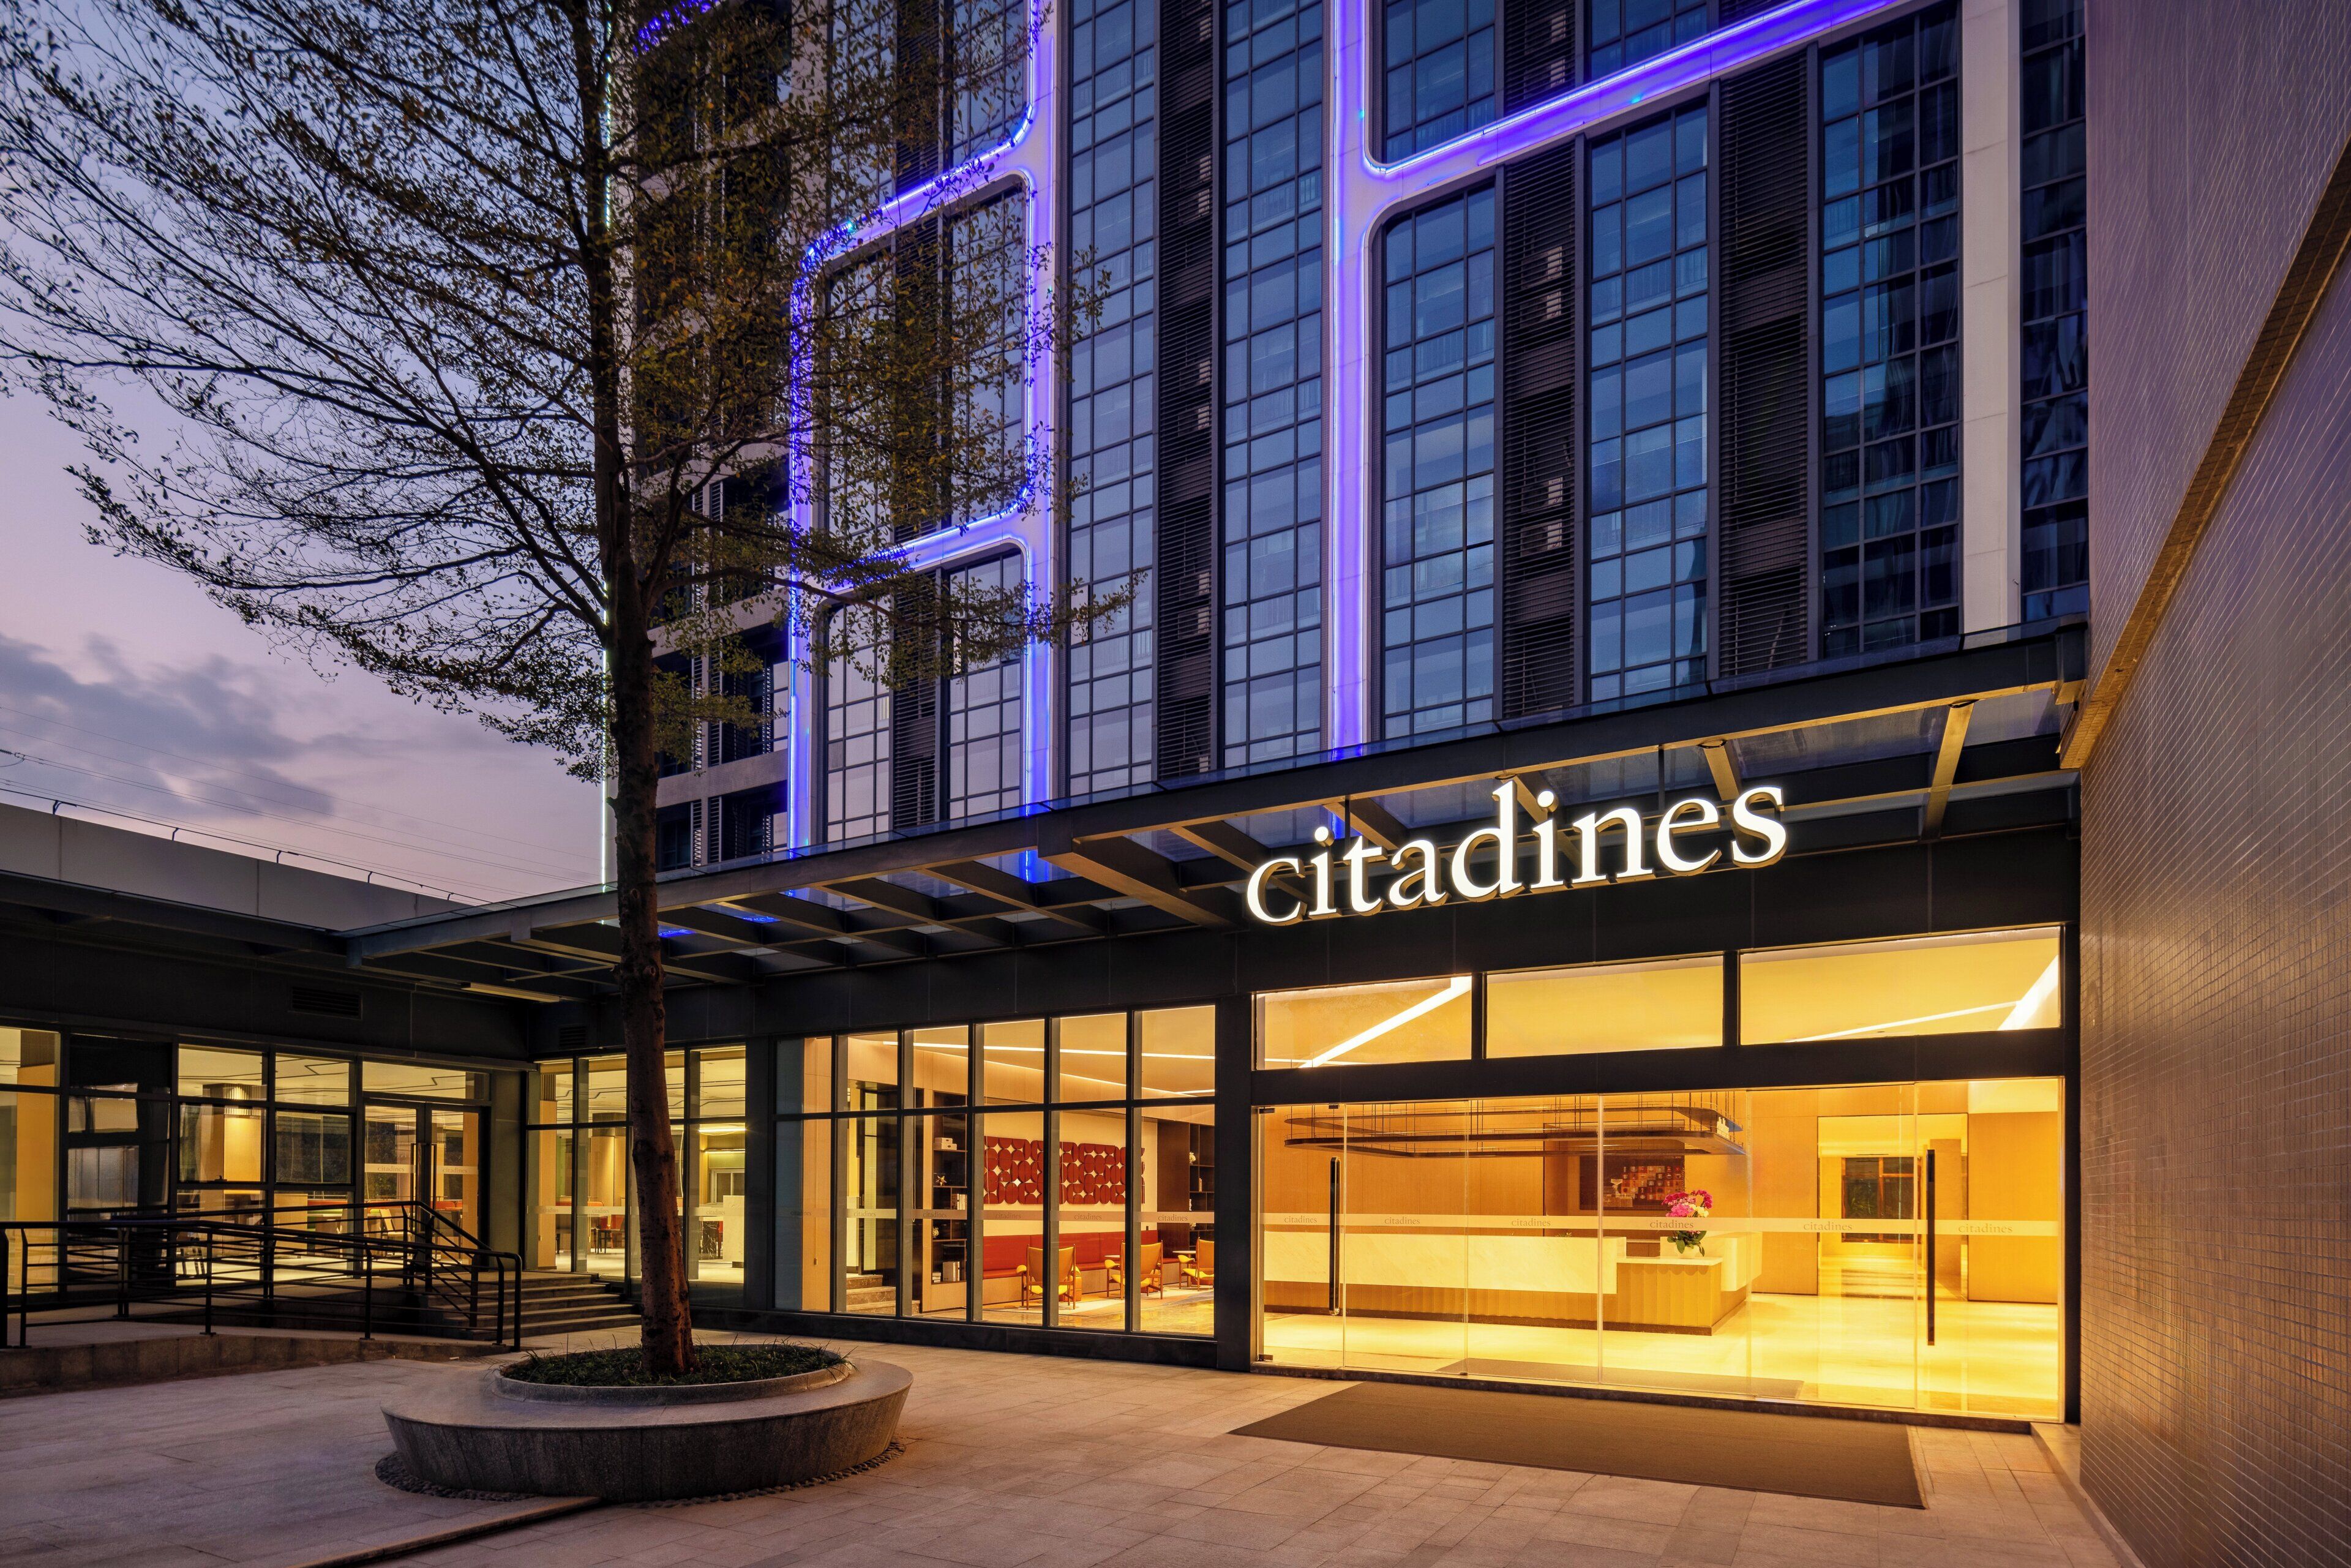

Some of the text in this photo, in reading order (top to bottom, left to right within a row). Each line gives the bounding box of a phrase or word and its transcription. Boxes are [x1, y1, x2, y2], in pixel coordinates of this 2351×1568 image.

[1247, 780, 1789, 925] citadines
[1511, 1218, 1551, 1226] citadines
[1650, 1219, 1693, 1228] citadines
[1803, 1221, 1853, 1231] citadines
[1959, 1223, 2013, 1233] citadines
